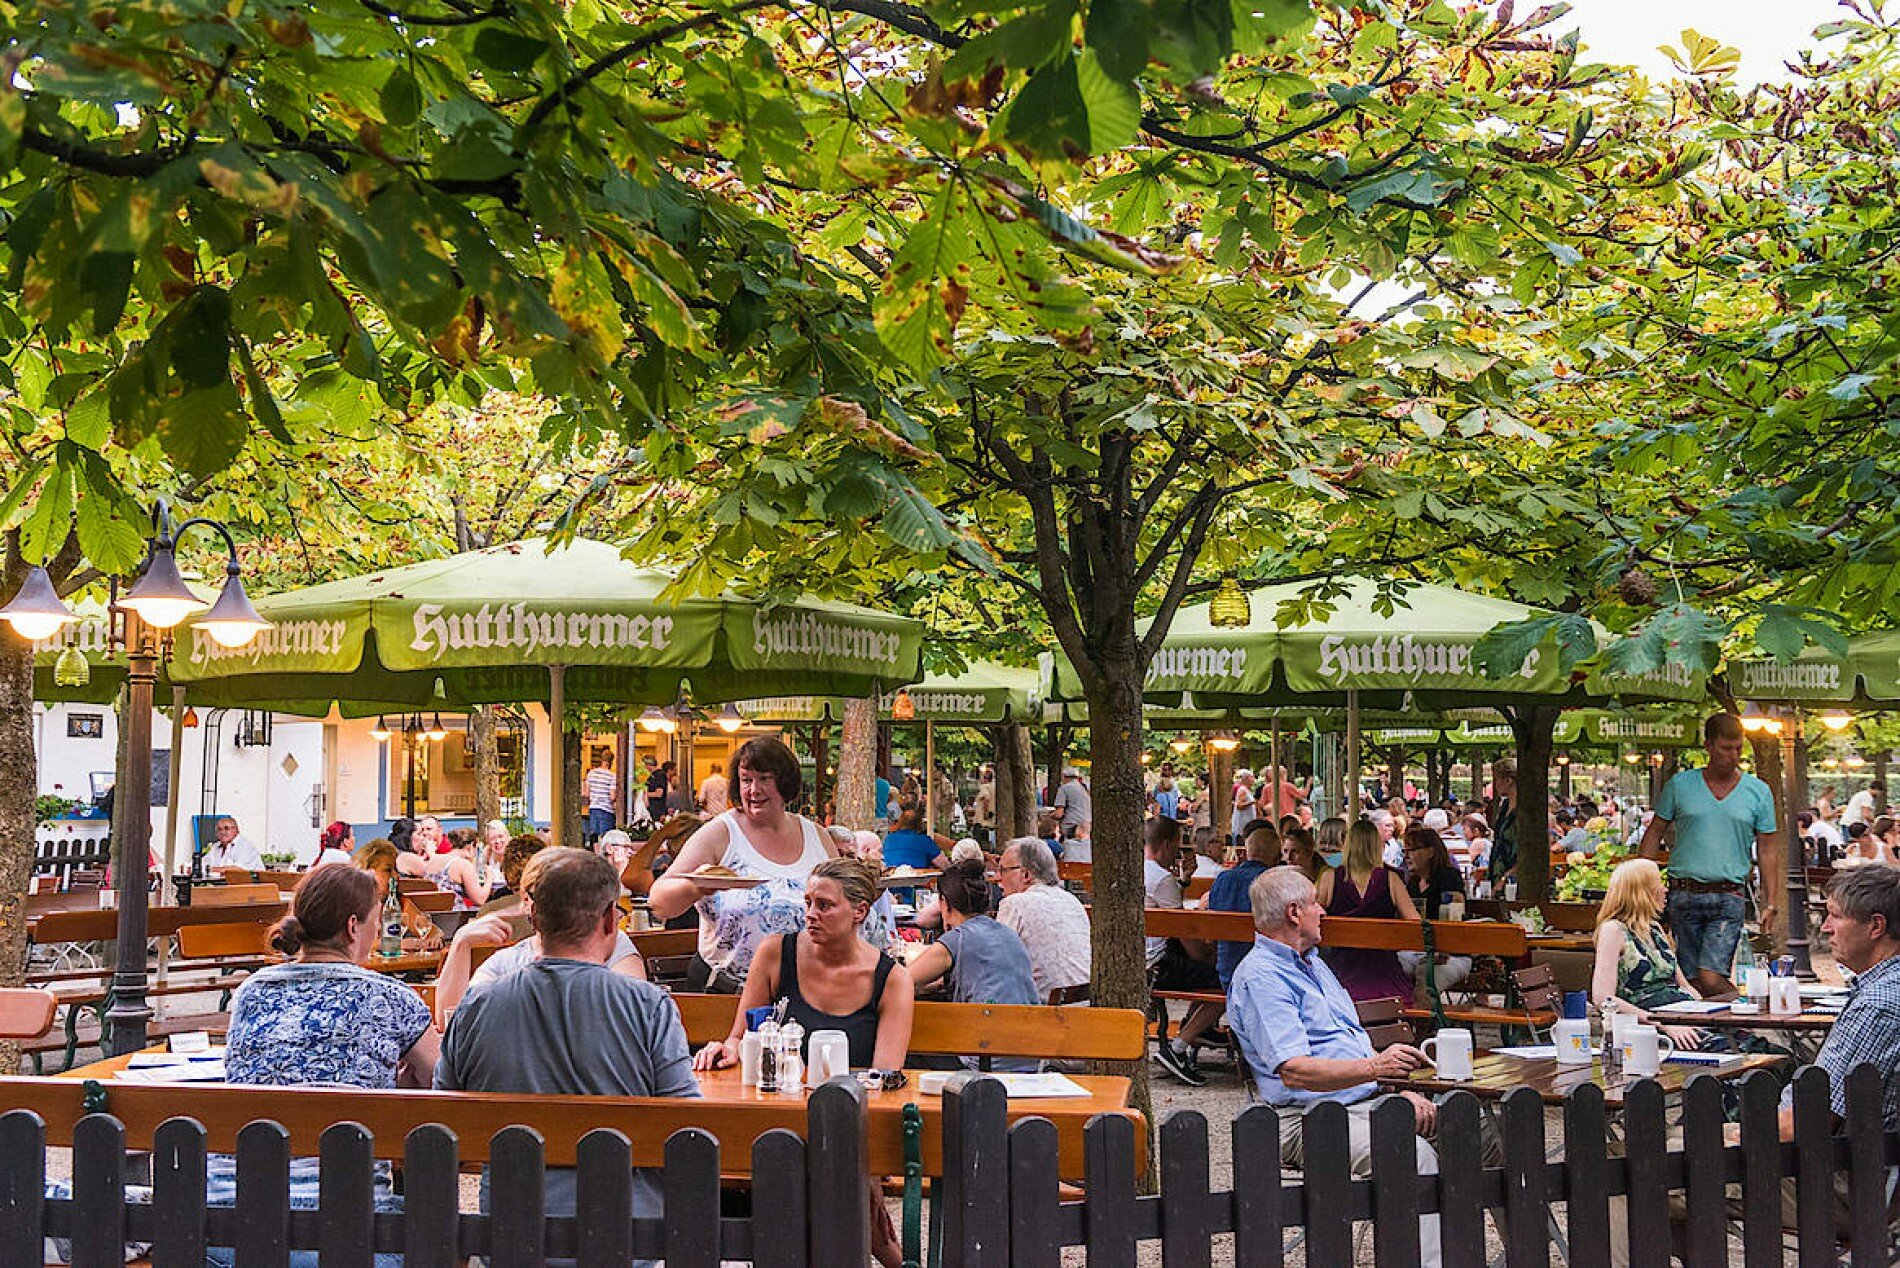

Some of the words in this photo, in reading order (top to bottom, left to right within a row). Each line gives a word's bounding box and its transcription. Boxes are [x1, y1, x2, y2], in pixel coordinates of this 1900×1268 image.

[410, 600, 674, 662] Hutthurmer
[752, 608, 900, 665] Hutthurmer
[1317, 634, 1541, 684] Hutthurr
